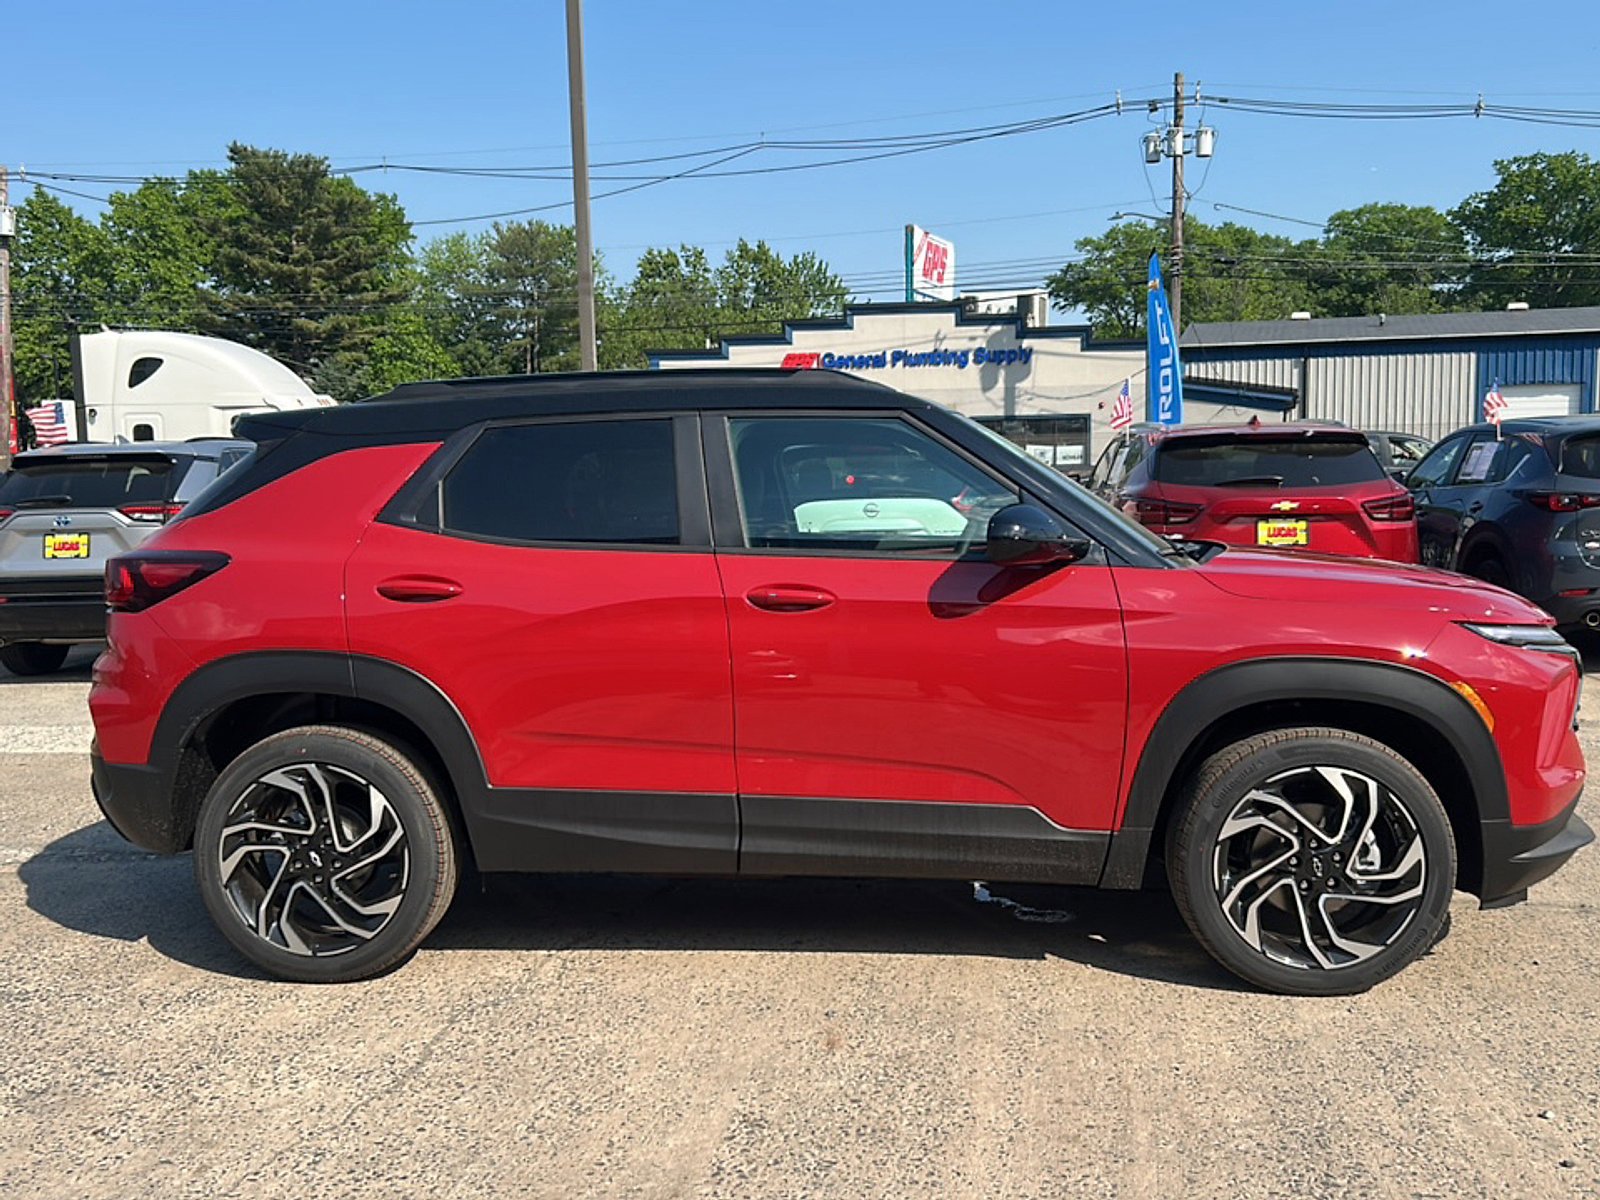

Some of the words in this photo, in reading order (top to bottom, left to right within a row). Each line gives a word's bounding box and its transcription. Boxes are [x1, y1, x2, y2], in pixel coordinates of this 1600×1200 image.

[923, 240, 948, 284] GPS
[822, 352, 887, 369] General
[891, 350, 969, 369] Plumbing
[972, 347, 1034, 366] Supply
[1267, 527, 1297, 538] LUCAS
[53, 541, 80, 551] LUCAS
